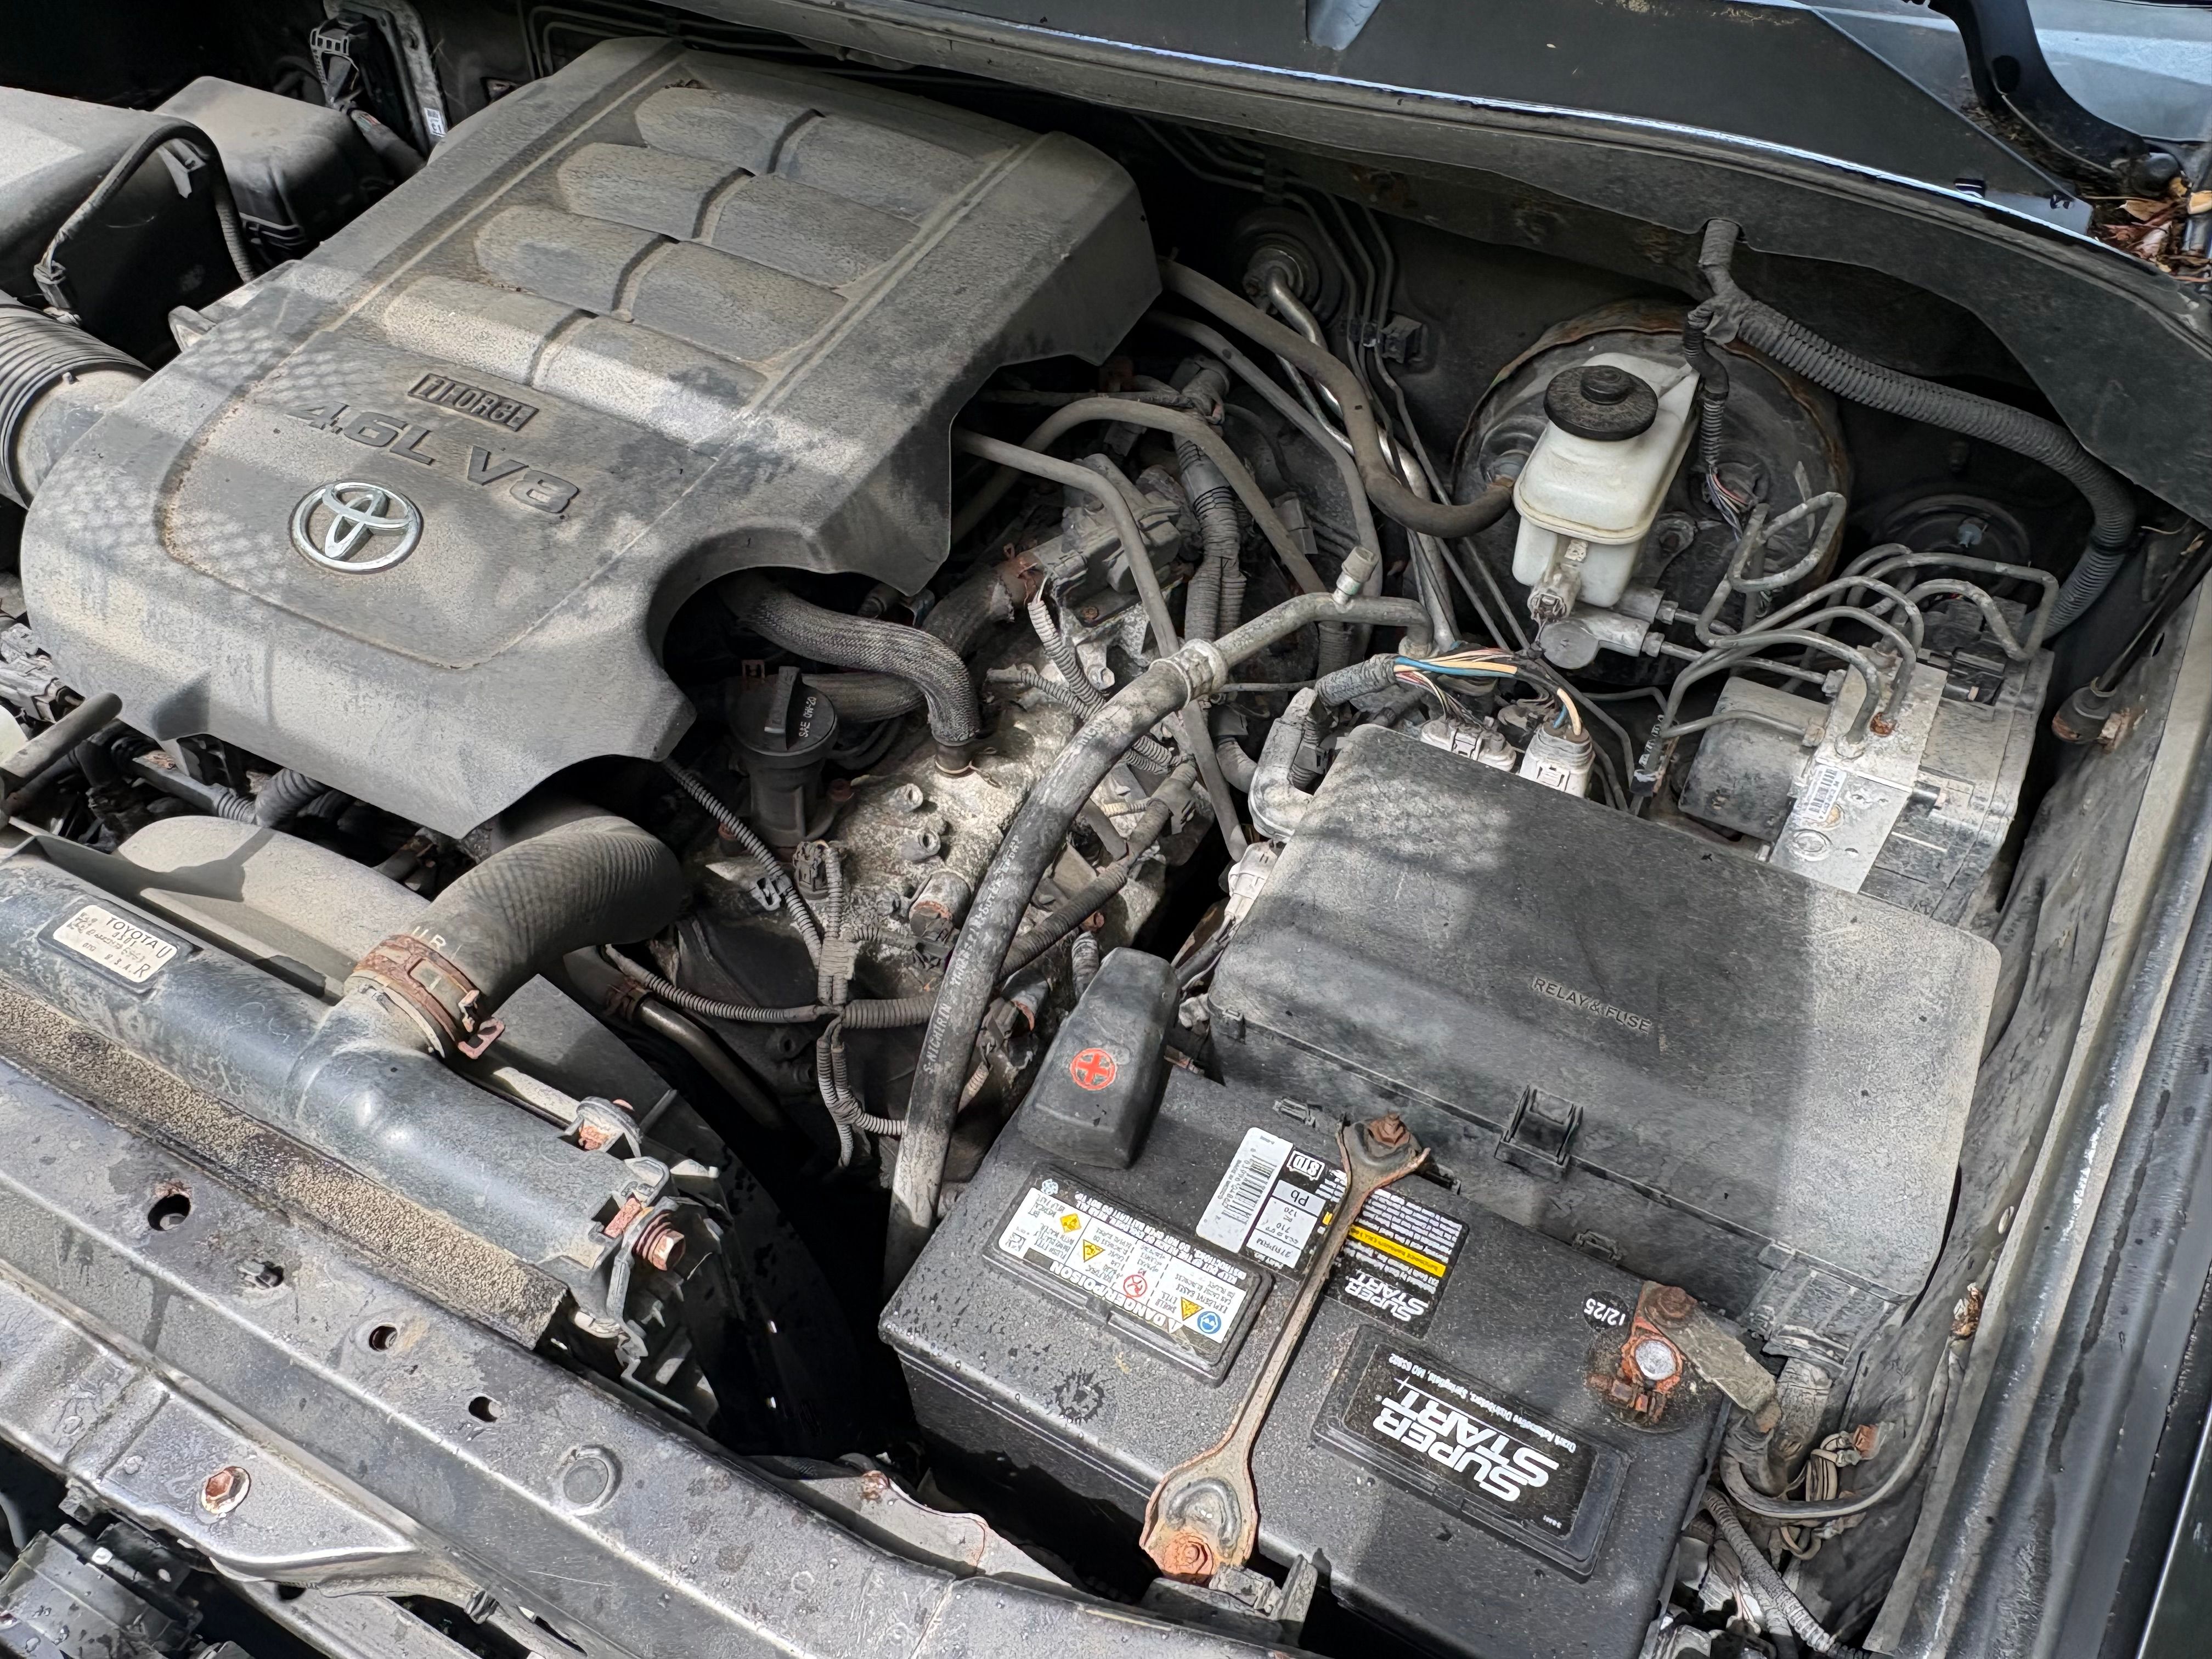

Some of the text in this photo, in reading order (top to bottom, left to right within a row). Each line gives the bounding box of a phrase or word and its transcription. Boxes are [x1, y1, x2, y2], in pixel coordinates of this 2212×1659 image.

[286, 401, 580, 514] 4.6L V8
[797, 695, 817, 738] SAE 0W-20
[106, 917, 159, 949] TOYOTA
[1534, 978, 1651, 1032] RELAY & FUSE
[1288, 1188, 1310, 1206] Pb
[1275, 1221, 1291, 1233] 710
[1049, 1261, 1166, 1326] DANGER/POISON
[1346, 1281, 1412, 1322] SUPER
[1350, 1270, 1430, 1317] START
[1582, 1297, 1627, 1329] 12/25
[1373, 1407, 1529, 1502] SUPER
[1381, 1390, 1560, 1488] START
